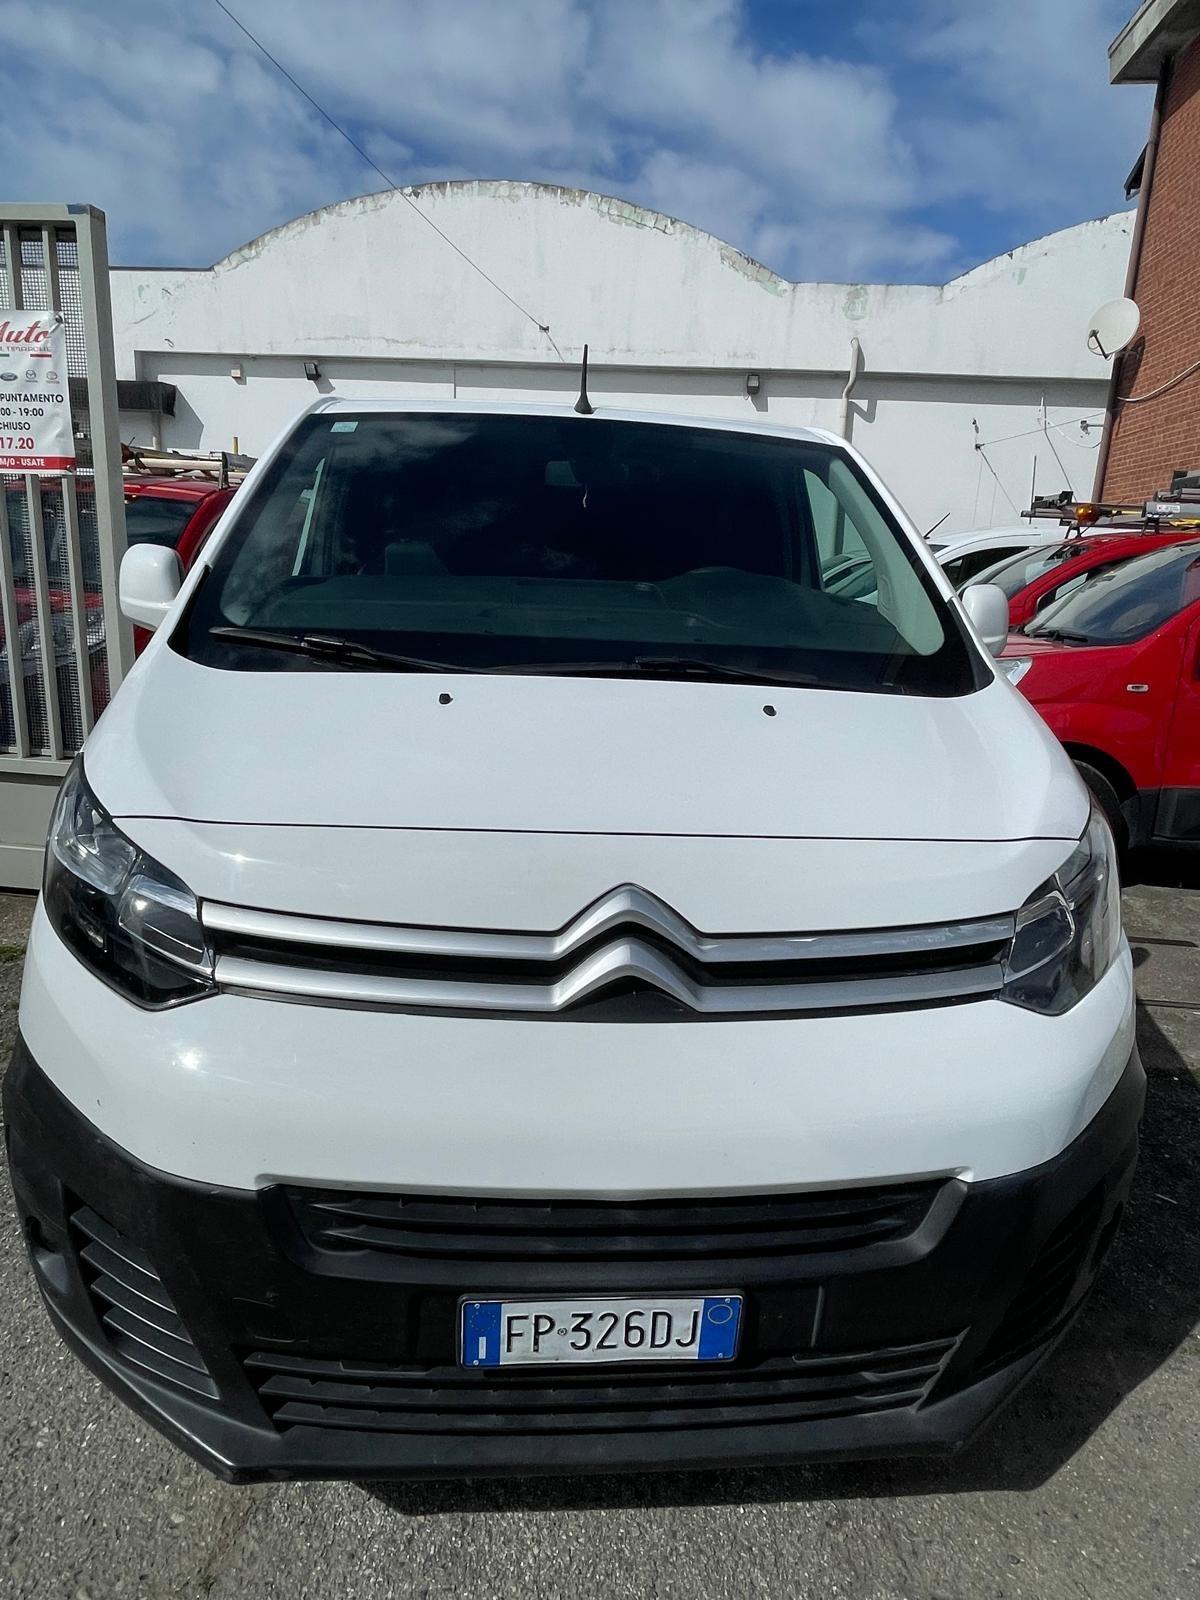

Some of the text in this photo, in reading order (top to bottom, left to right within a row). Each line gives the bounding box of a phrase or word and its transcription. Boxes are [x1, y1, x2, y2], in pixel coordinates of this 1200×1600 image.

[0, 393, 64, 403] PUNTAMENTO
[19, 407, 44, 417] 19:00
[21, 458, 45, 467] USATE
